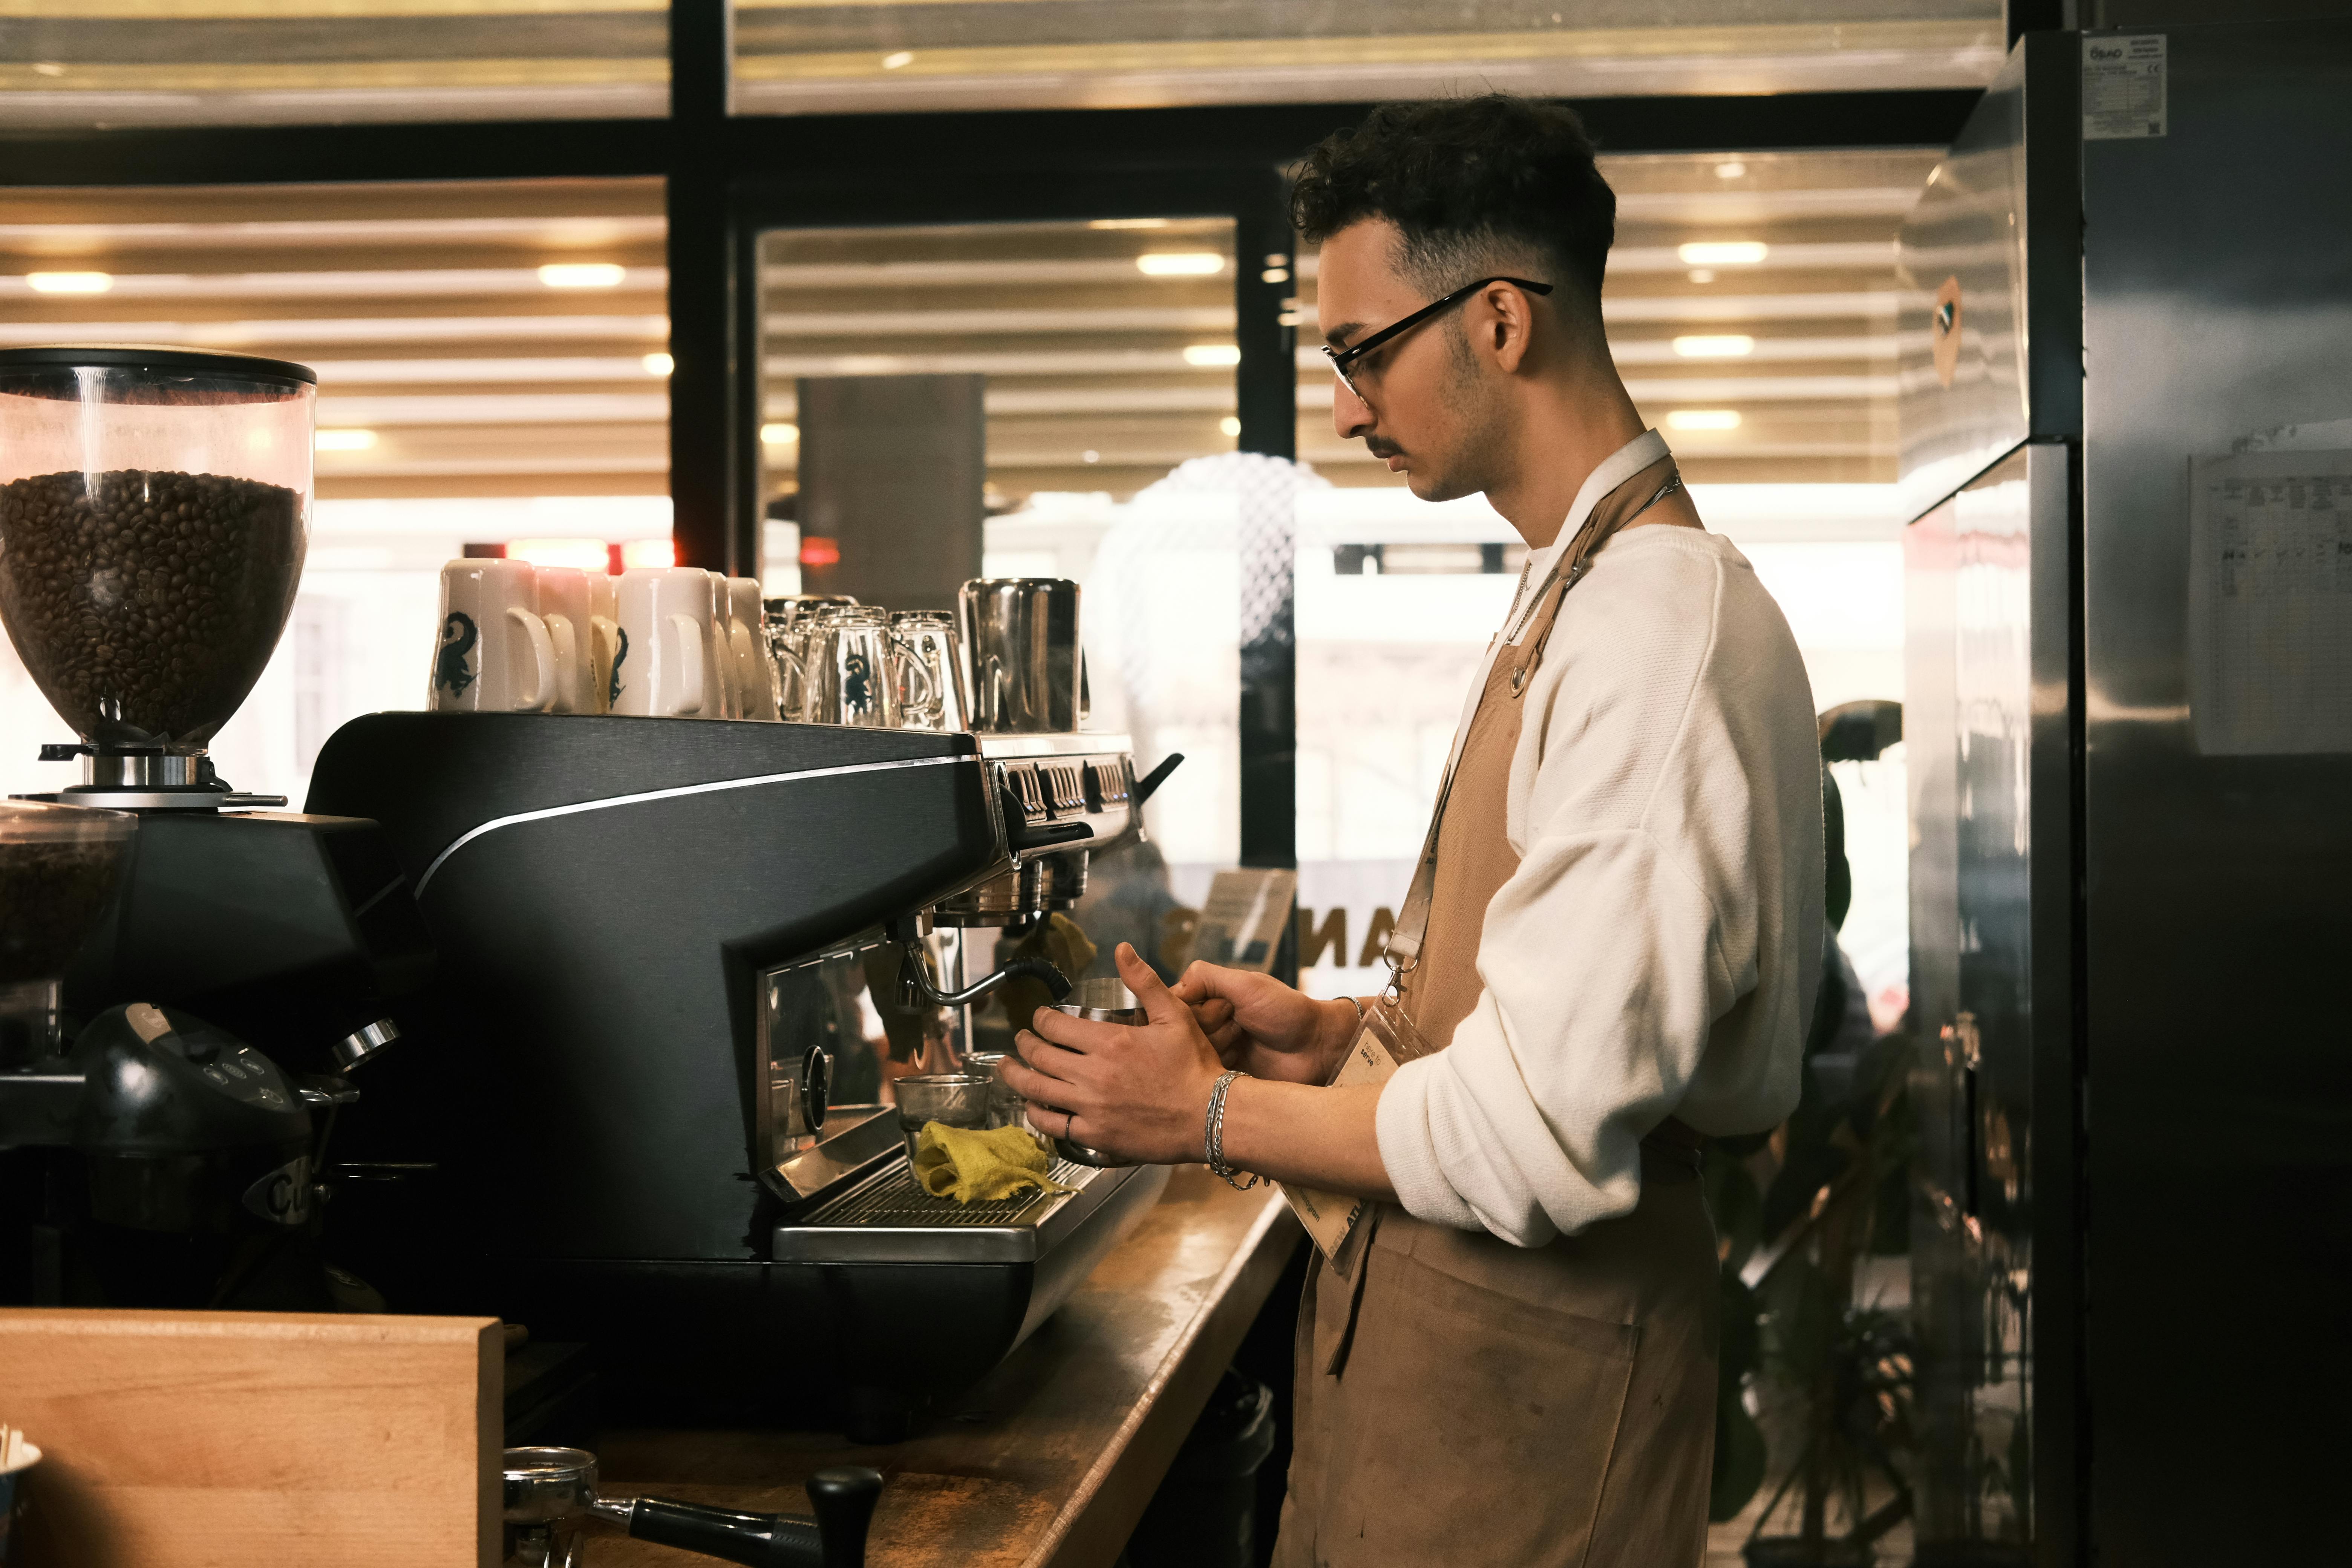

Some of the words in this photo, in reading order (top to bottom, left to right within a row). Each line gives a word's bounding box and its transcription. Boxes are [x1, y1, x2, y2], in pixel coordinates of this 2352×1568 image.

[1360, 1049, 1374, 1067] serve
[1364, 1040, 1375, 1058] here
[1376, 1055, 1381, 1065] to
